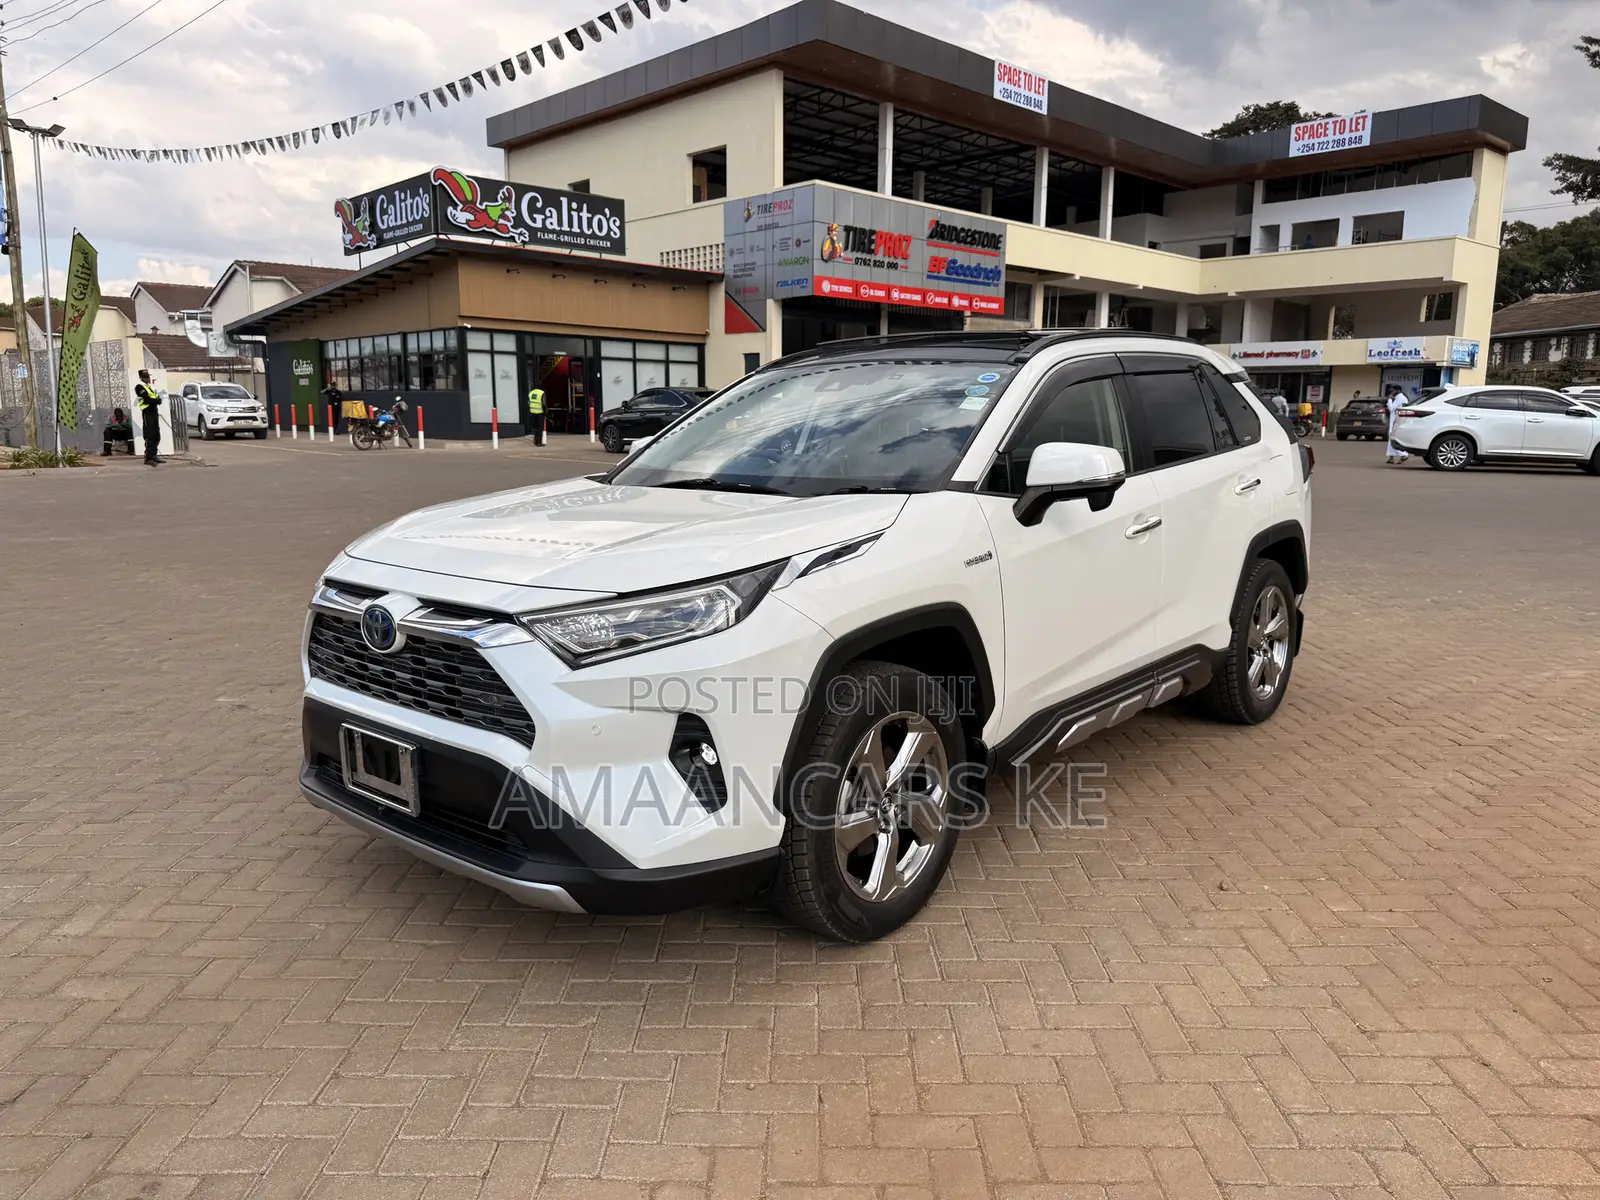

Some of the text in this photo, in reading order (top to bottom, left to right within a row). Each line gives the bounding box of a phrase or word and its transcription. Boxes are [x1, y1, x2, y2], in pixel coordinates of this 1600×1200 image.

[998, 62, 1046, 96] SPACE TO LET
[999, 88, 1012, 100] +254
[1013, 91, 1022, 104] 722
[1294, 115, 1368, 142] SPACE TO LET
[1297, 135, 1363, 153] +254 722 288 848
[376, 188, 430, 229] Galito's
[521, 192, 620, 238] Galito's
[757, 200, 793, 215] TIREPROZ
[537, 232, 611, 248] FLAME-GRILLED CHICKEN
[843, 225, 913, 260] TIREPROZ
[927, 219, 1003, 250] BRIDGESTONE
[778, 256, 809, 267] AMARON
[854, 256, 899, 270] 0762 820 000
[776, 278, 808, 288] FALKEN
[1266, 350, 1300, 359] pharmacy
[1368, 348, 1420, 357] Leofresh
